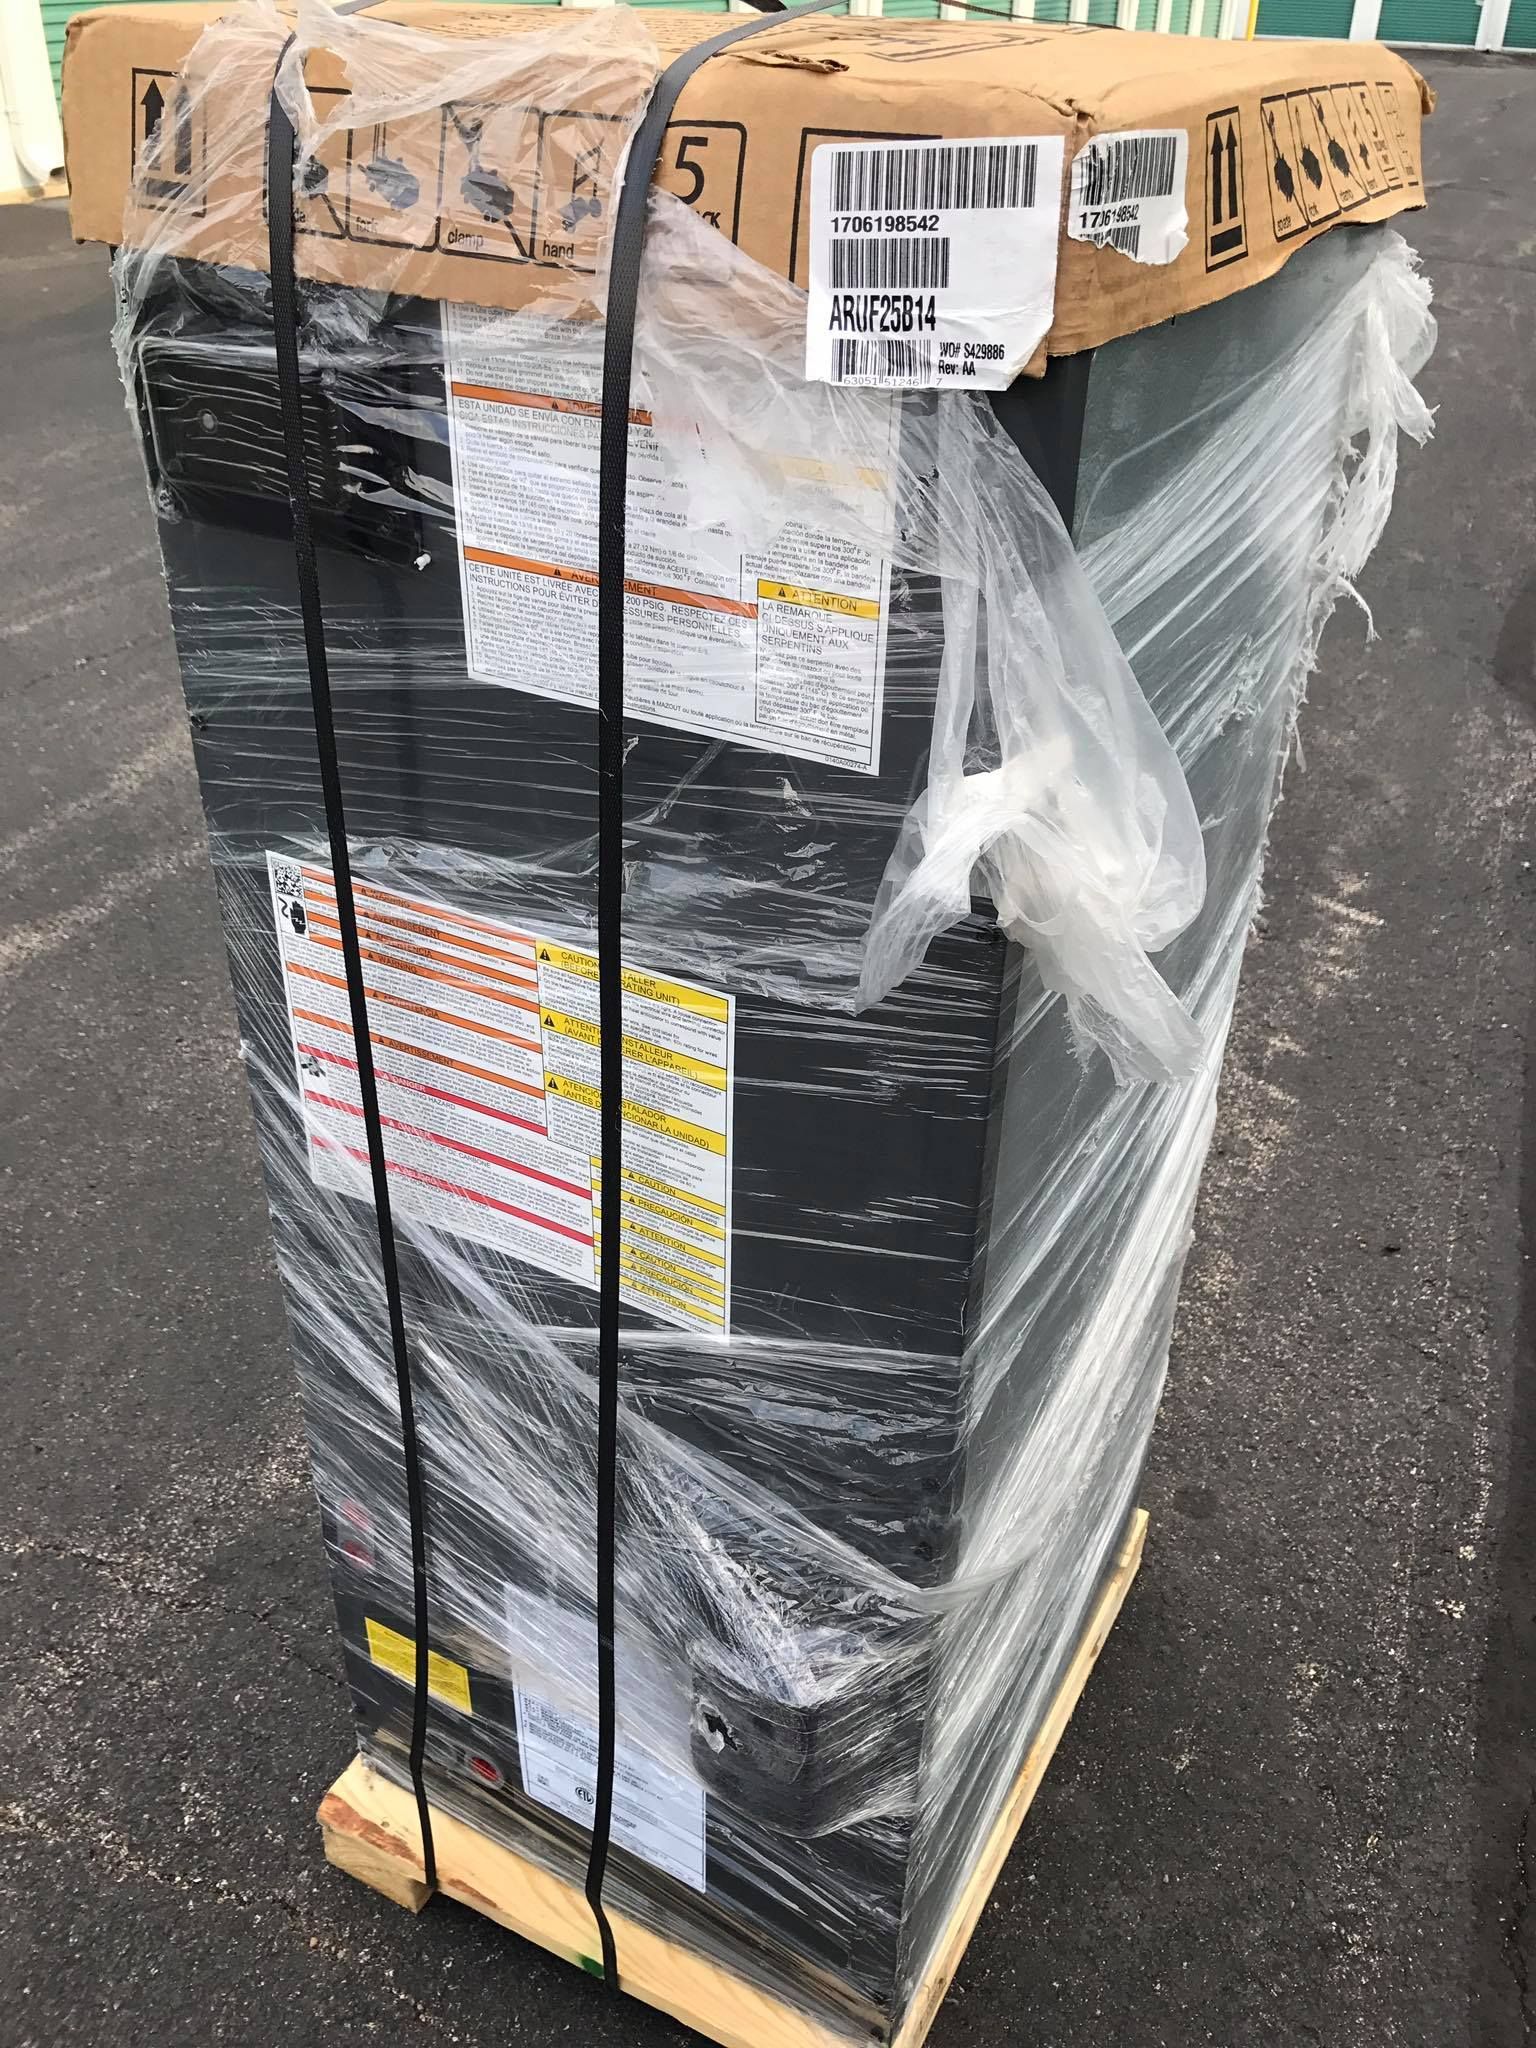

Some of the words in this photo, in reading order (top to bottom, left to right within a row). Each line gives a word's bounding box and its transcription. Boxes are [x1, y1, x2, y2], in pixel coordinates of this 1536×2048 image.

[671, 136, 708, 205] 5
[831, 215, 939, 233] 1706198542
[448, 229, 484, 249] clamp
[542, 240, 574, 260] hand
[829, 295, 936, 333] ARUF25B14
[964, 343, 1005, 360] S429886
[938, 360, 959, 375] Rev:
[962, 361, 976, 376] AA
[458, 399, 480, 411] ESTA
[482, 402, 516, 416] UNIDAD
[518, 408, 530, 418] SE
[560, 414, 580, 426] CON
[512, 419, 584, 438] INSTRUCCIONES
[468, 562, 495, 576] CETTE
[497, 567, 522, 581] UNITÉ
[524, 573, 540, 585] EST
[542, 576, 572, 592] LIVRÉE
[574, 584, 598, 597] AVEC
[626, 595, 640, 606] 200
[642, 599, 666, 612] PSIG.
[671, 604, 725, 624] RESPECTEZ
[728, 616, 747, 628] CES
[469, 573, 530, 594] INSTRUCTIONS
[532, 586, 557, 599] POUR
[559, 590, 589, 606] ÉVITER
[622, 605, 664, 622] ESSURES
[667, 615, 740, 638] PERSONNELLES
[792, 589, 857, 611] ATTENTION
[762, 601, 774, 611] LA
[776, 603, 832, 623] REMARQUE
[775, 615, 814, 631] DESSUS
[761, 634, 822, 655] SERPENTINS
[762, 623, 828, 645] UNIQUEMENT
[828, 637, 848, 649] AUX
[377, 953, 417, 974] WARNING
[560, 950, 599, 970] CAUTION
[622, 971, 656, 989] TALLER
[560, 959, 599, 979] (BEFORE
[621, 979, 653, 997] RATING
[655, 990, 679, 1006] UNIT)
[564, 1026, 596, 1044] (AVANT
[391, 1074, 426, 1093] DANGER
[427, 1095, 456, 1111] HAZARD
[622, 1100, 666, 1123] STALADOR
[563, 1090, 595, 1106] (ANTES
[660, 1123, 671, 1134] LA
[673, 1128, 708, 1148] UNIDAD)
[458, 1151, 491, 1169] CARBONE
[638, 1175, 675, 1196] CAUTION
[638, 1226, 685, 1251] ATTENTION
[639, 1251, 676, 1271] CAUTION
